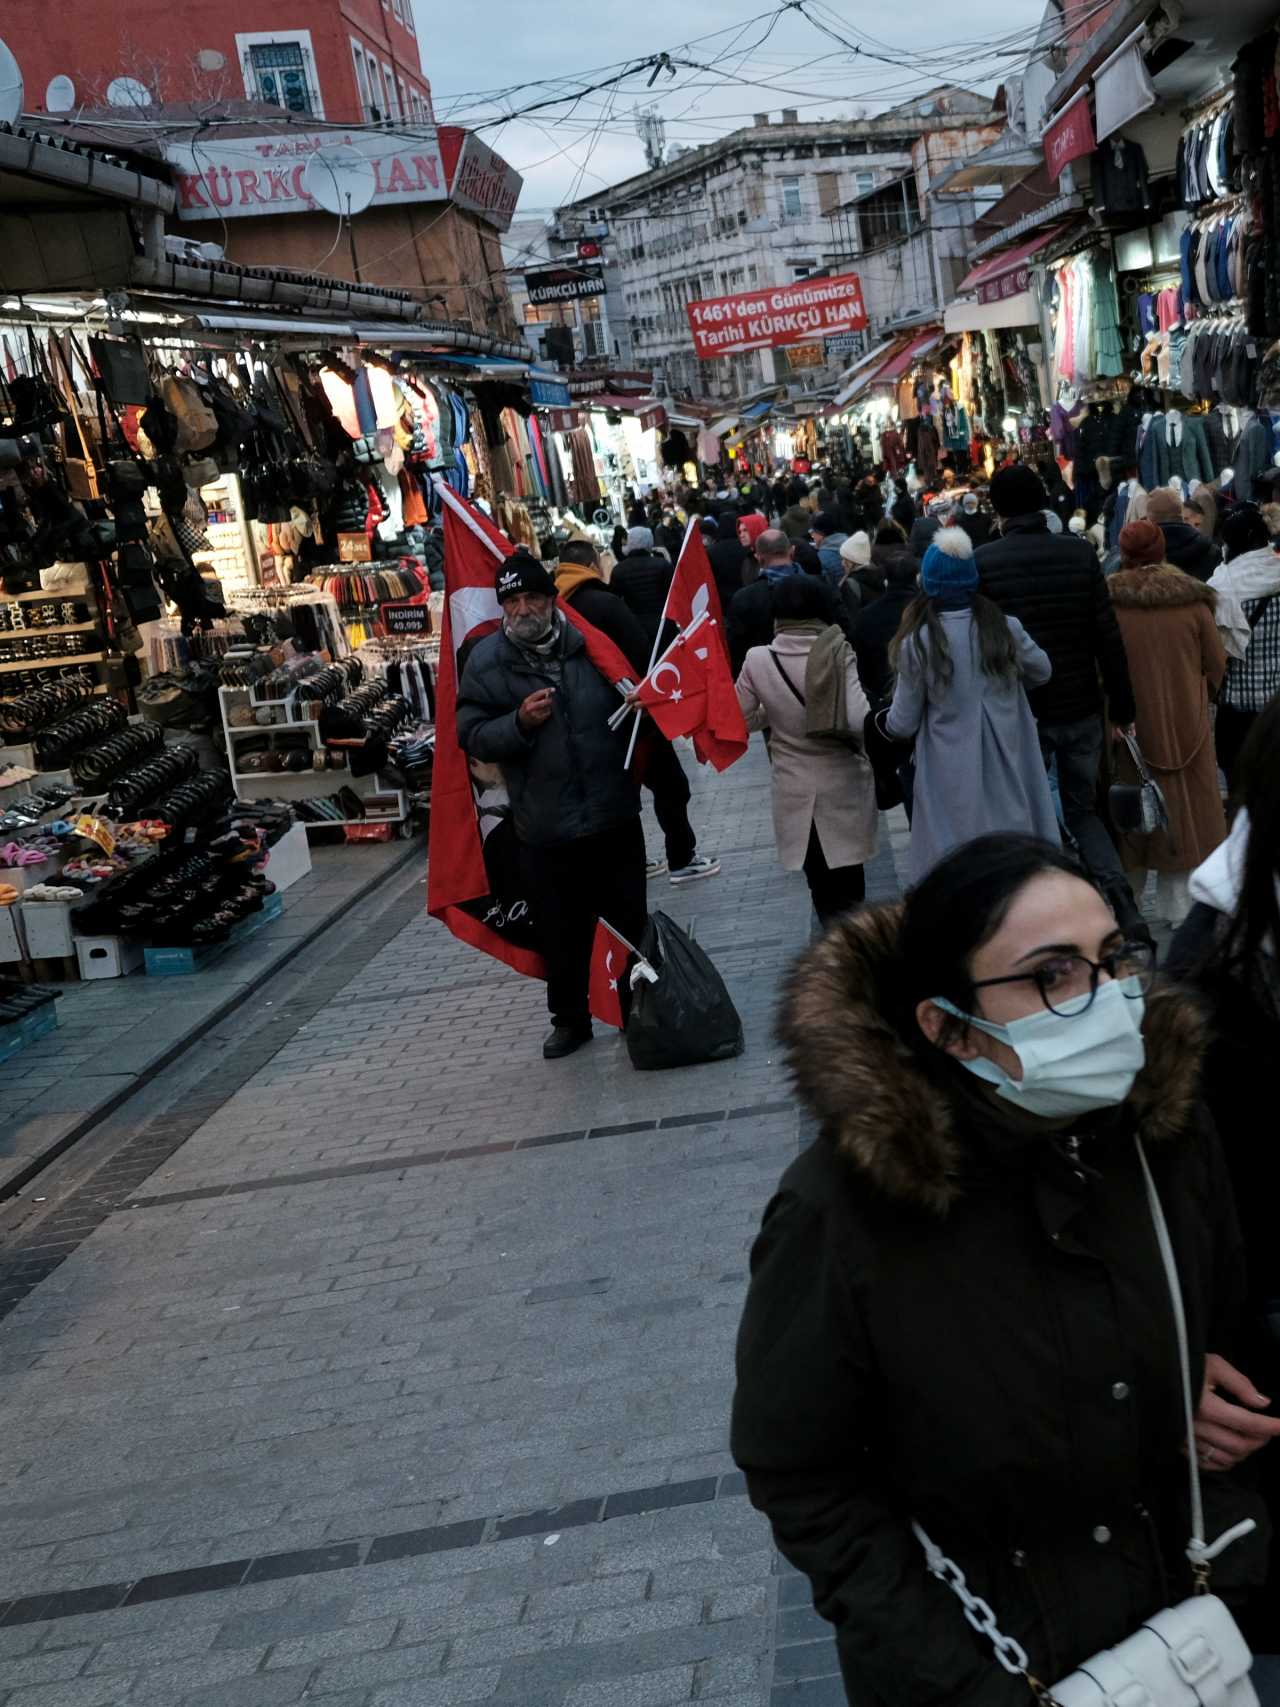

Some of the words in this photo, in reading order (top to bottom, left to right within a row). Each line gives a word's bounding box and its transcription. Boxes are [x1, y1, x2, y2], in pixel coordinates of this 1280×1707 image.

[177, 165, 317, 210] KÜRKÇ
[529, 282, 577, 301] KÜRKÇÜ
[578, 279, 604, 295] HAN
[692, 300, 767, 325] 1461'den
[771, 283, 855, 310] Günümüze
[696, 322, 745, 347] Tarihi
[748, 307, 821, 338] KÜRKÇÜ
[825, 301, 862, 323] HAN
